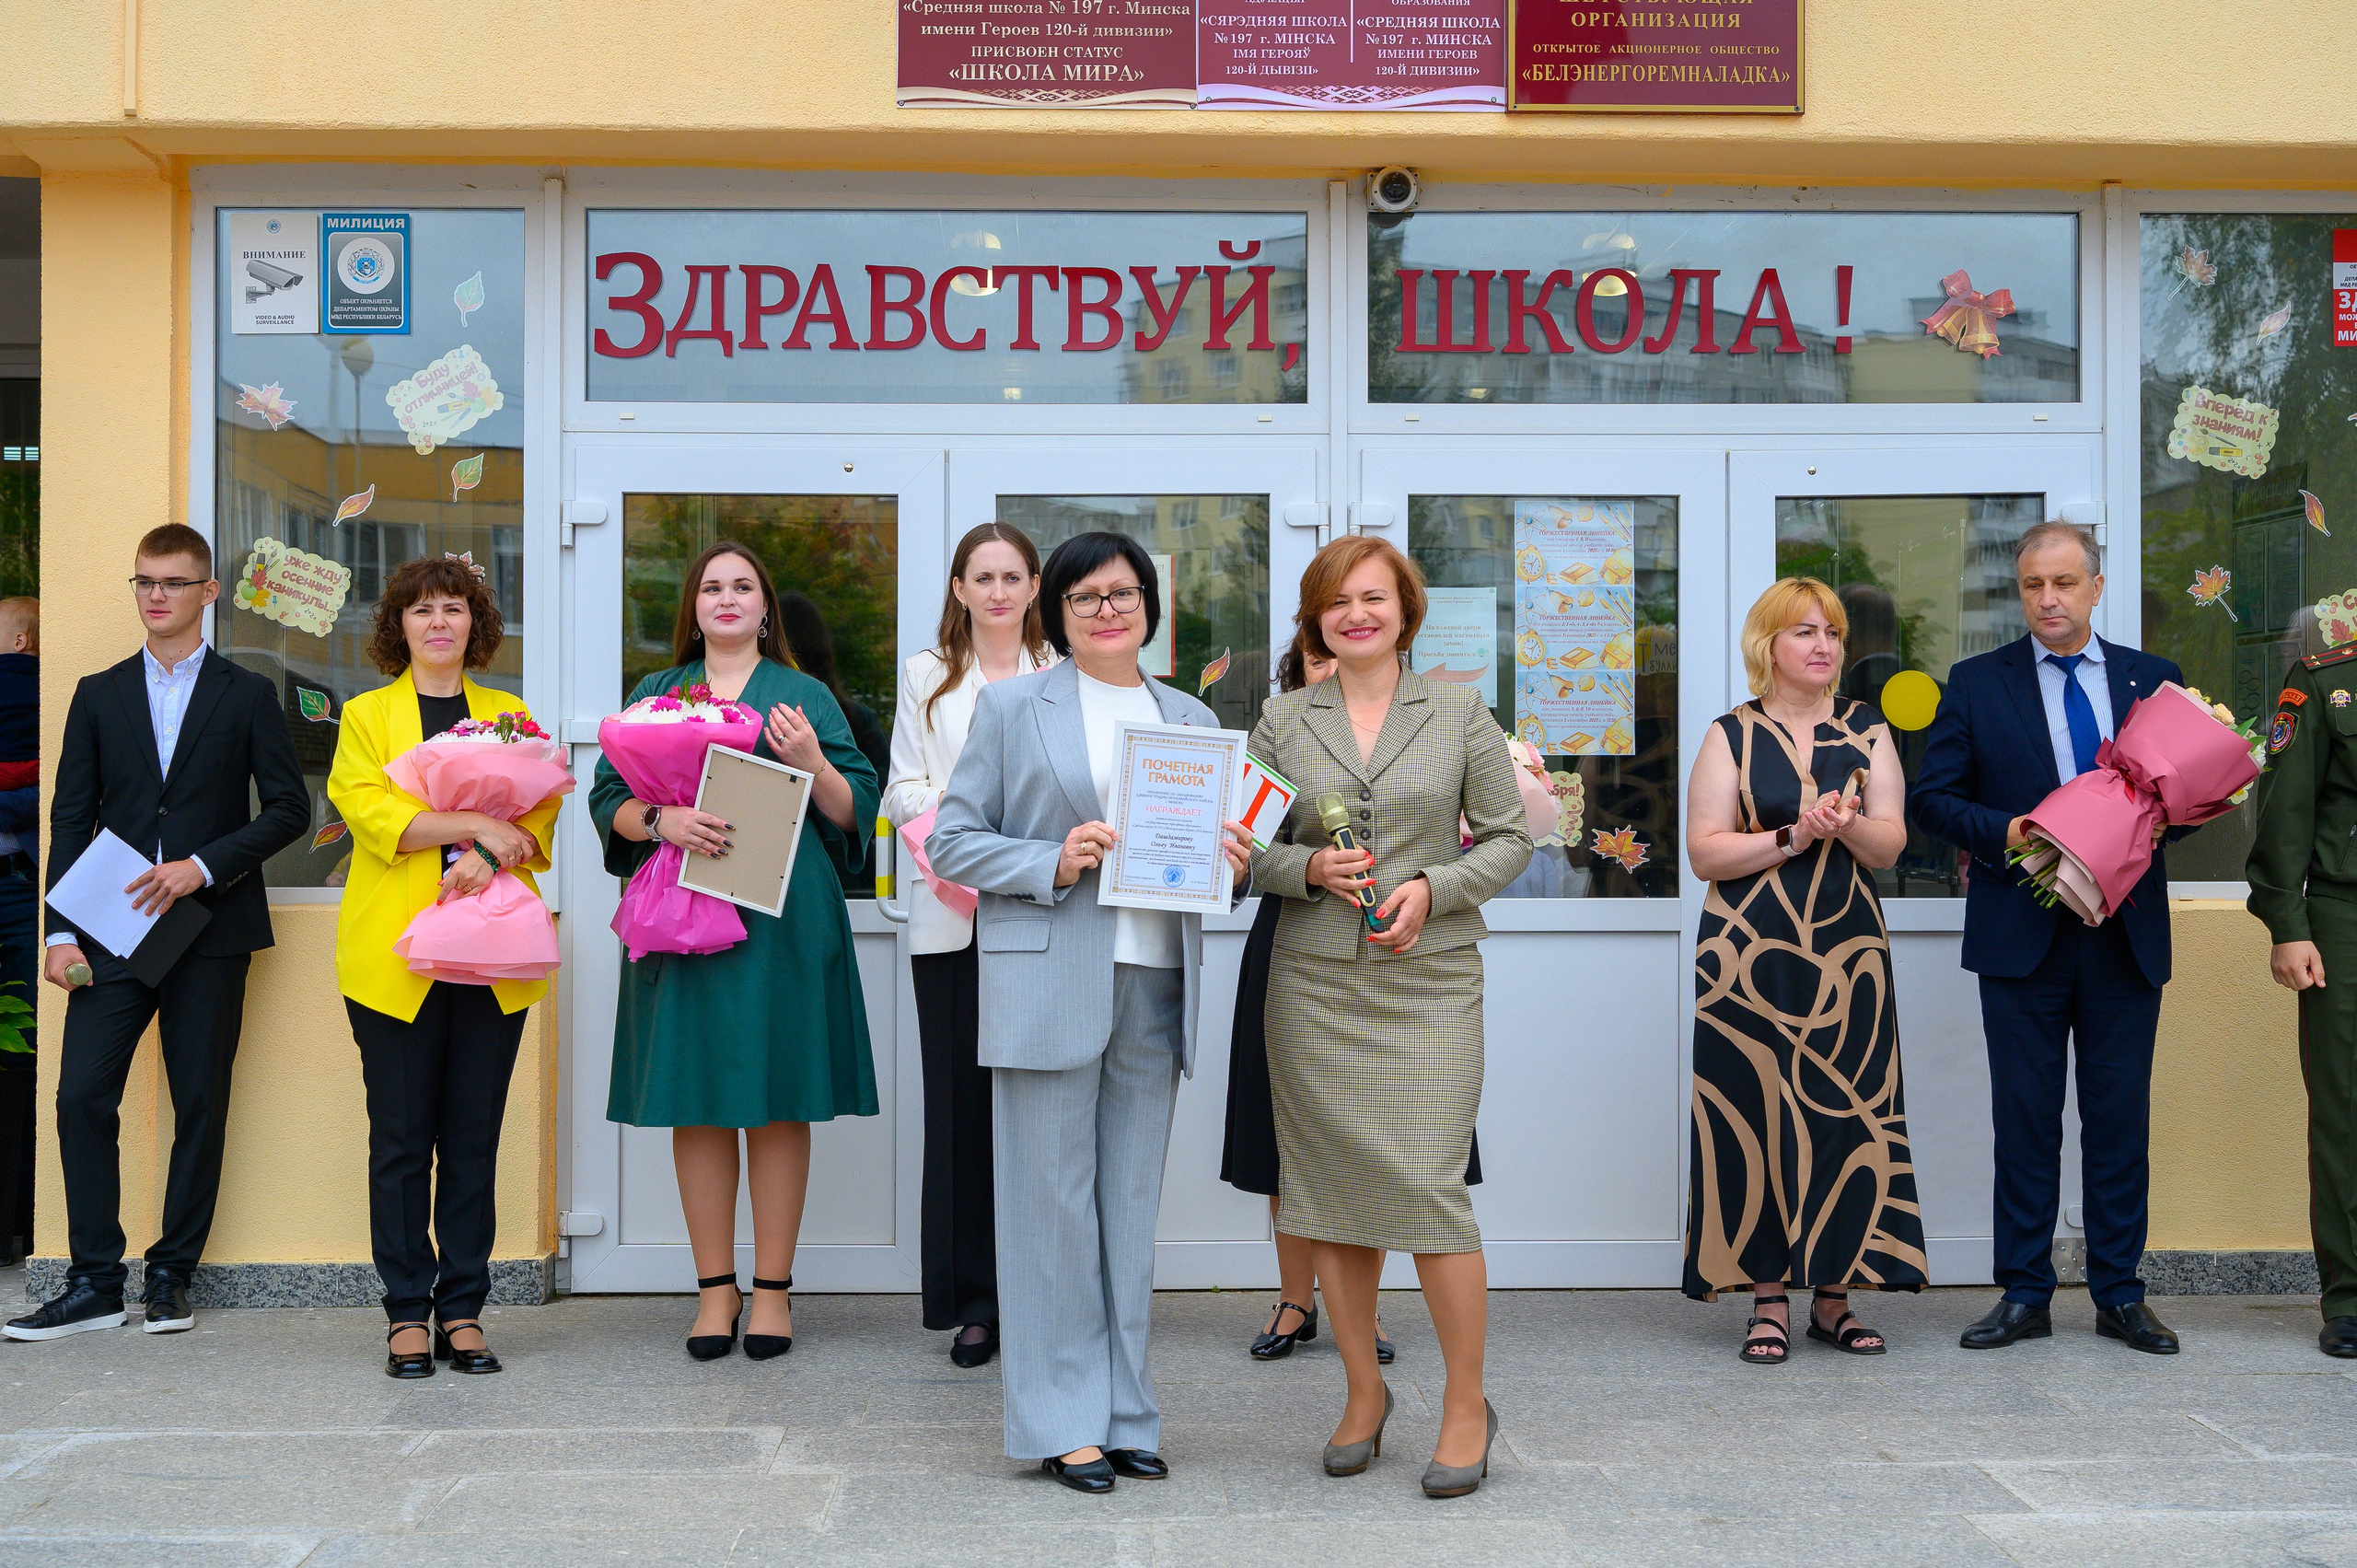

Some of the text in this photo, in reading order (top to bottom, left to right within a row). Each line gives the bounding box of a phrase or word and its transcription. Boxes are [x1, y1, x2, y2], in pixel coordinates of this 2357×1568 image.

[902, 0, 1191, 16] «Средняя школа № 197 г. Минска
[1200, 15, 1348, 28] «СЯРЭДНЯЯ ШКОЛА
[1356, 17, 1501, 29] «СРЕДНЯЯ ШКОЛА
[1571, 12, 1741, 30] ОРГАНИЗАЦИЯ
[922, 22, 1173, 39] имени Героев 120-й дивизии»
[1260, 35, 1271, 44] г.
[1274, 33, 1336, 45] МІНСКА
[1411, 36, 1421, 45] г.
[1425, 34, 1492, 46] МИНСКА
[970, 45, 1123, 58] ПРИСВОЕН СТАТУС
[1233, 46, 1311, 59] ІМЯ ГЕРОЯЎ
[1377, 49, 1478, 60] ИМЕНИ ГЕРОЕВ
[1533, 43, 1780, 55] ОТКРЫТОЕ АКЦИОНЕРНОЕ ОБЩЕСТВО
[948, 63, 1144, 82] «ШКОЛА МИРА»
[1225, 63, 1318, 76] 120-Й ДЫВІЗІІ»
[1376, 64, 1480, 77] 120-Й ДИВИЗИИ»
[1522, 64, 1791, 86] «БЕЛЭНЕРГОРЕМНАЛАДКА»
[327, 217, 405, 230] МИЛИЦИЯ
[242, 250, 307, 260] ВНИМАНИЕ
[594, 239, 1299, 371] ЗДРАВСТВУЙ,
[2338, 331, 2357, 341] МИ
[414, 364, 450, 389] Буду
[404, 361, 479, 414] отличницей!
[2194, 392, 2256, 424] Вперёд
[2191, 413, 2264, 442] знаниям!
[313, 565, 343, 585] жду
[281, 570, 334, 597] осенние
[1142, 758, 1214, 775] ПОЧЕТНАЯ
[1147, 772, 1206, 787] ГРАМОТА
[1551, 784, 1580, 800] бря!
[1145, 805, 1203, 817] НАГРАЖДАЕТ
